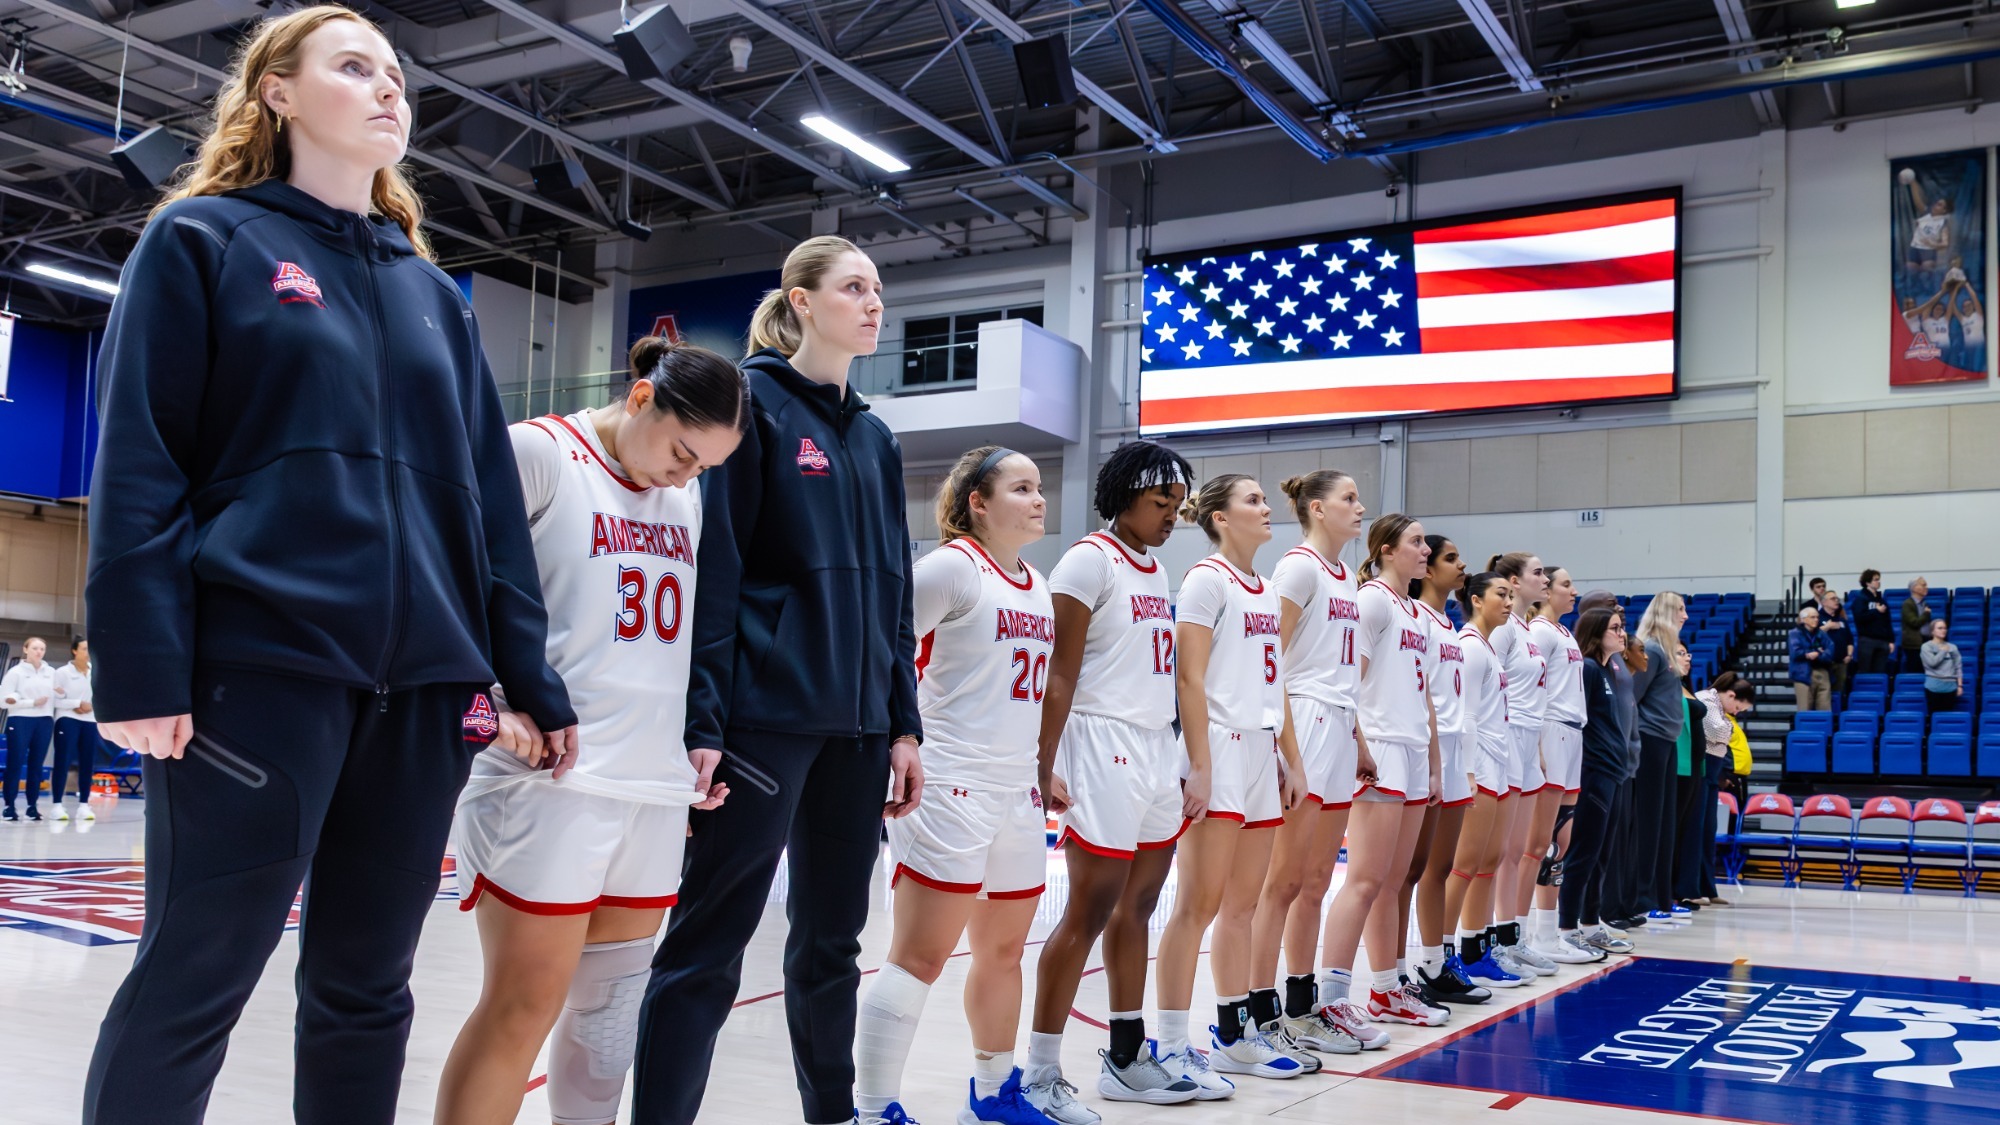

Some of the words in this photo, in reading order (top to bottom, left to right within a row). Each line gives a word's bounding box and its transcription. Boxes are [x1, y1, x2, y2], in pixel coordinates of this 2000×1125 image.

[1582, 511, 1599, 522] 115
[589, 511, 695, 570] AMERICAN
[614, 563, 683, 644] 30
[995, 608, 1055, 647] AMERICA
[1340, 627, 1355, 666] 11
[1152, 627, 1173, 675] 12
[1263, 643, 1277, 685] 5
[1010, 647, 1047, 704] 20
[1454, 667, 1462, 698] 0
[464, 718, 498, 730] AMERICAN
[1579, 978, 1775, 1070] LEAGUE
[1689, 984, 1856, 1084] PATRIOT
